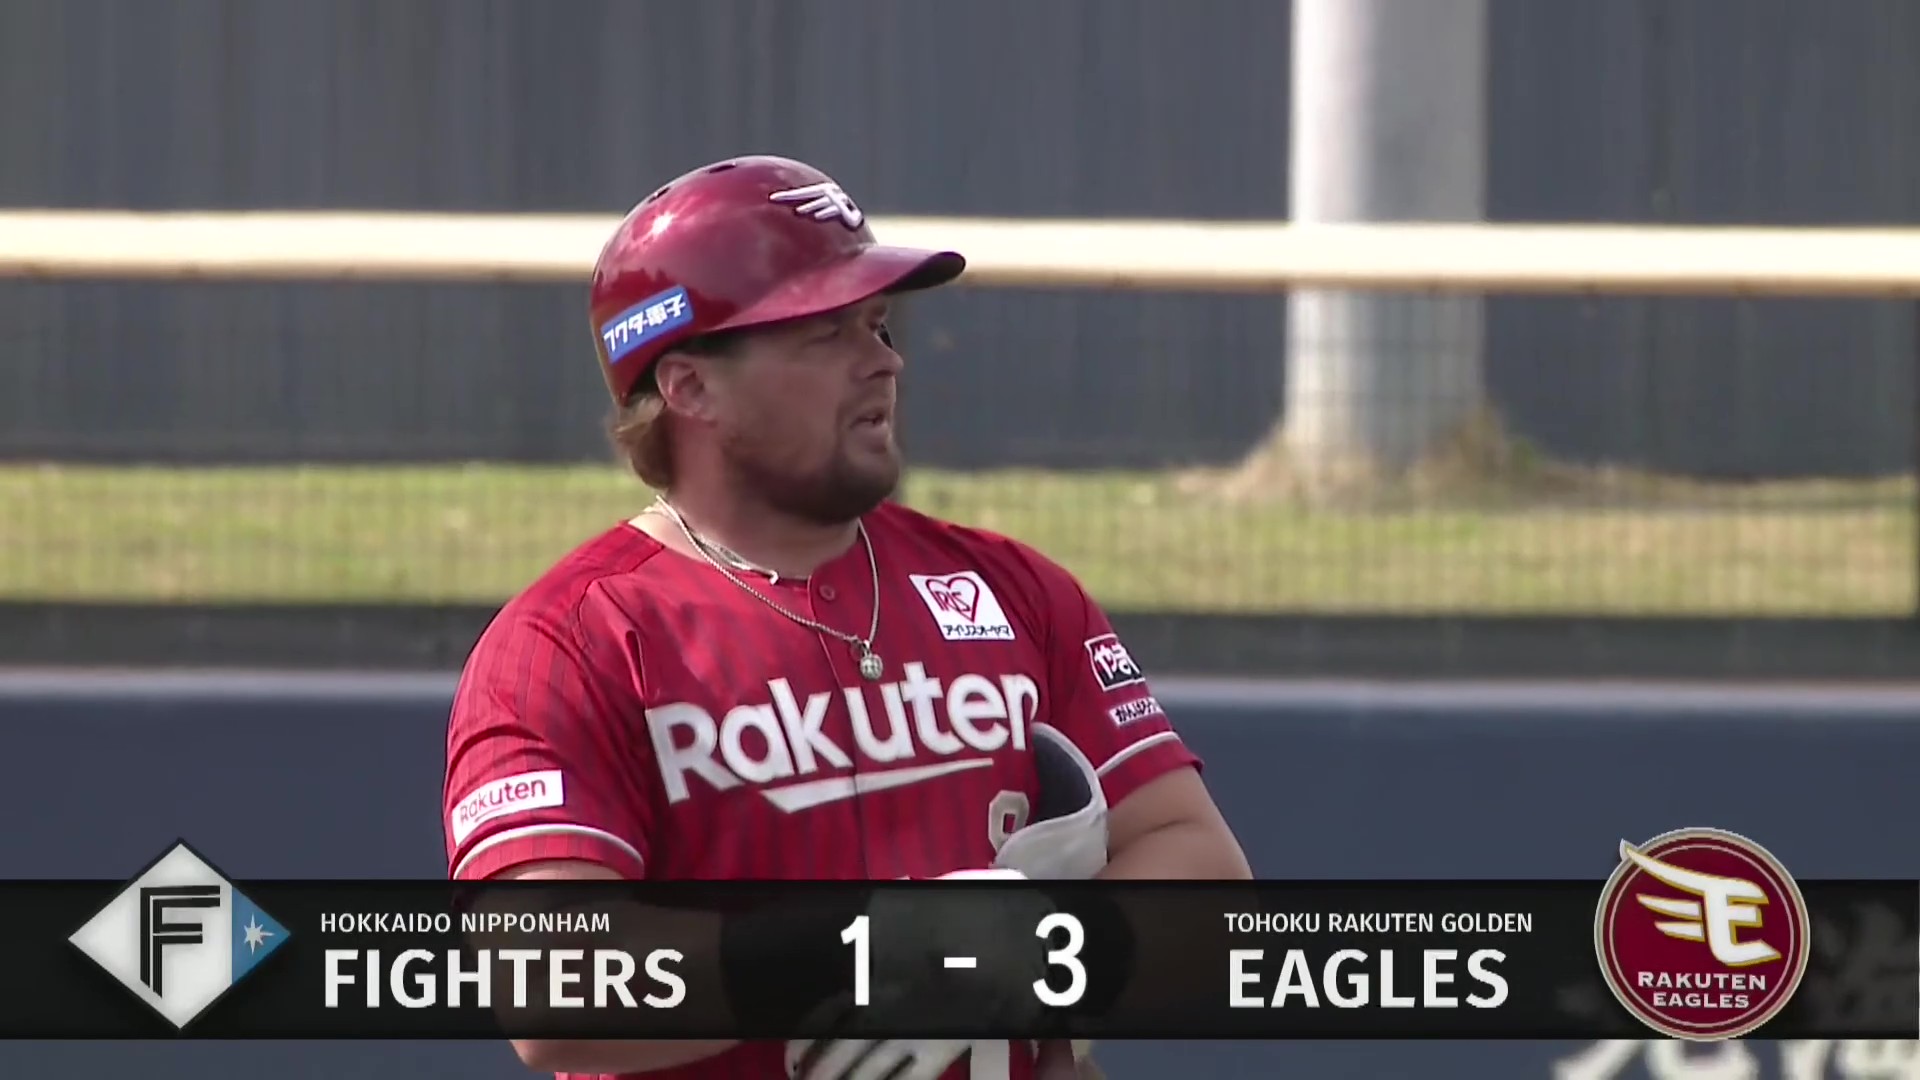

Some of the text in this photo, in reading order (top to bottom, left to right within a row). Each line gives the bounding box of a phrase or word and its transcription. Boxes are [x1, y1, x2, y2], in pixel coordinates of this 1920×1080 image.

[931, 591, 972, 612] IRIS
[943, 625, 1010, 636] アイリスオーヤマ
[646, 661, 1039, 805] Rakuten
[460, 779, 546, 825] Rakuten
